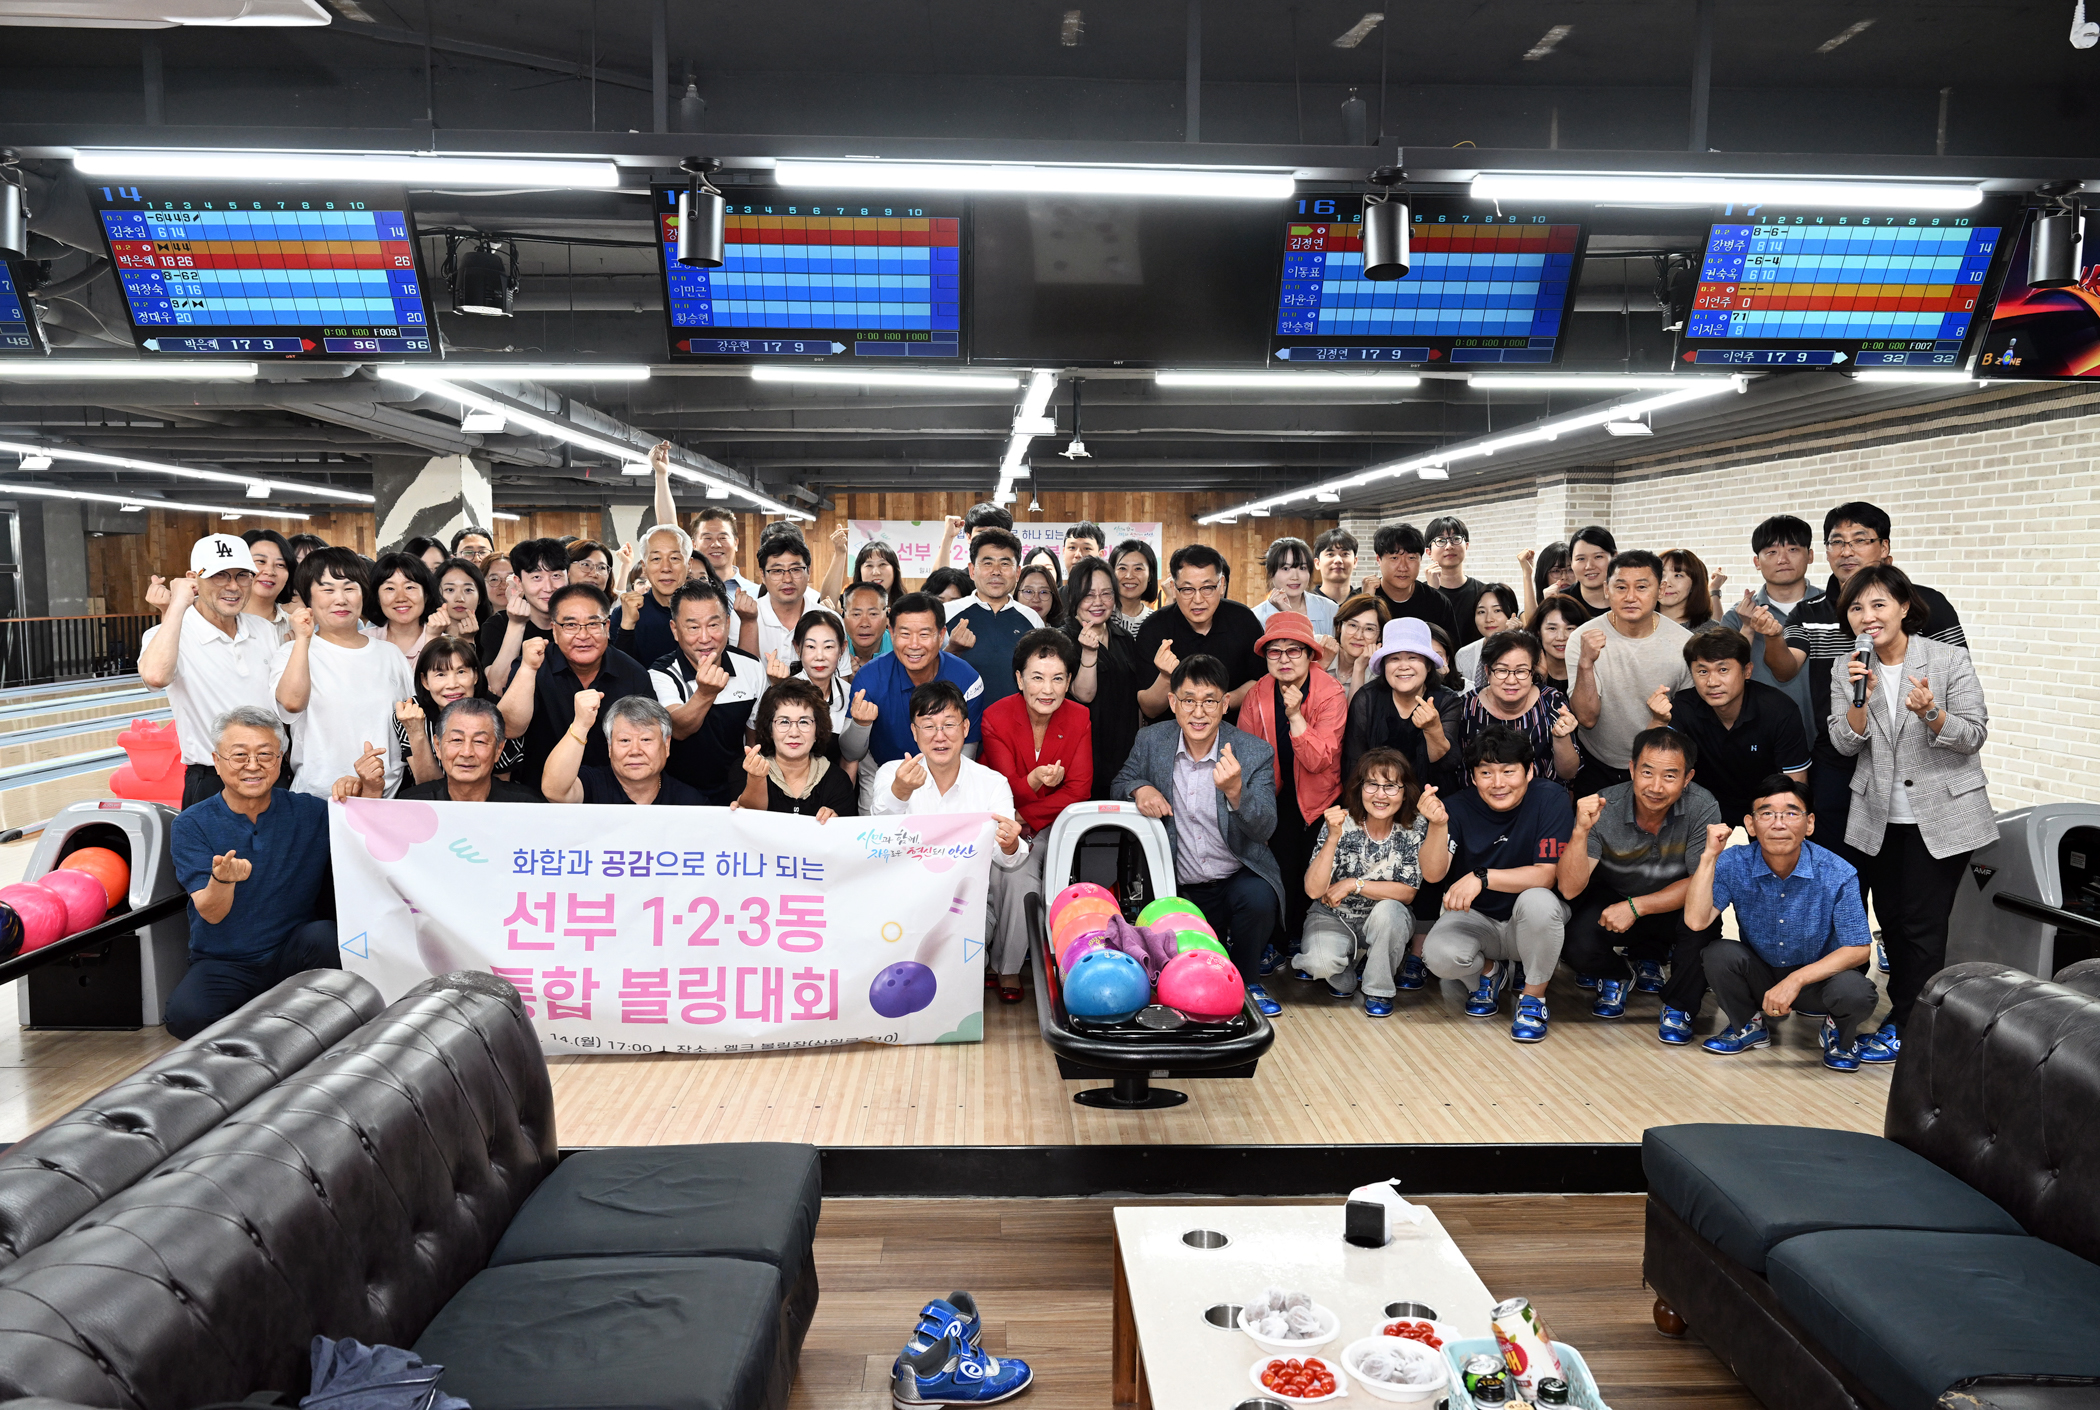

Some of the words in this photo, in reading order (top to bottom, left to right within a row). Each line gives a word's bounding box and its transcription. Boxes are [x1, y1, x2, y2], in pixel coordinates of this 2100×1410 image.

[98, 186, 143, 202] 14
[147, 201, 154, 210] 1
[165, 201, 174, 210] 2
[183, 201, 192, 210] 3
[204, 201, 213, 210] 4
[229, 201, 238, 210] 5
[252, 201, 262, 210] 6
[277, 201, 286, 210] 7
[301, 201, 310, 210] 8
[326, 201, 334, 210] 9
[349, 201, 365, 210] 10
[725, 206, 734, 214] 2
[744, 206, 752, 214] 3
[764, 206, 772, 214] 4
[789, 206, 797, 215] 5
[812, 207, 821, 215] 6
[837, 207, 844, 215] 7
[860, 208, 869, 216] 8
[884, 208, 892, 216] 9
[907, 208, 923, 216] 10
[1295, 199, 1336, 215] 16
[1336, 214, 1341, 222] 1
[1352, 214, 1361, 222] 2
[1414, 214, 1423, 222] 5
[1437, 215, 1446, 223] 6
[1462, 215, 1470, 223] 7
[1484, 215, 1493, 223] 8
[1508, 215, 1517, 224] 9
[1531, 215, 1546, 224] 10
[1761, 216, 1767, 224] 1
[1777, 216, 1786, 224] 2
[1795, 216, 1804, 224] 3
[1816, 216, 1824, 225] 4
[1839, 216, 1847, 225] 5
[1862, 217, 1870, 225] 6
[1886, 217, 1894, 225] 7
[1908, 217, 1917, 226] 8
[1931, 217, 1940, 226] 9
[1954, 218, 1969, 226] 10
[157, 227, 167, 238] 6
[169, 227, 186, 238] 14
[389, 226, 405, 238] 14
[1290, 237, 1324, 250] 김정연
[1712, 239, 1746, 252] 강병주
[1757, 241, 1766, 252] 8
[1769, 241, 1783, 252] 14
[1978, 242, 1993, 254] 14
[160, 256, 176, 267] 18
[176, 256, 194, 267] 26
[394, 256, 411, 267] 26
[1749, 269, 1758, 280] 6
[1762, 270, 1775, 280] 10
[1969, 270, 1983, 283] 10
[128, 283, 164, 296] 박창숙
[174, 284, 184, 295] 8
[186, 284, 202, 295] 16
[401, 284, 417, 295] 16
[674, 285, 707, 297] 이민근
[1699, 296, 1732, 308] 이언주
[1742, 298, 1751, 308] 0
[1964, 299, 1974, 310] 0
[12, 308, 20, 318] 9
[137, 311, 172, 324] 정대우
[175, 312, 192, 323] 20
[406, 312, 423, 323] 20
[324, 328, 347, 336] 0:00
[373, 328, 397, 336] F009
[1692, 323, 1724, 336] 이지은
[1735, 325, 1743, 335] 8
[1955, 326, 1964, 337] 8
[6, 337, 29, 346] 48
[856, 332, 879, 340] 0:00
[230, 339, 251, 350] 17
[263, 339, 274, 350] 9
[353, 340, 376, 349] 96
[406, 340, 429, 349] 96
[717, 341, 750, 353] 강우현
[762, 342, 782, 352] 17
[794, 342, 805, 352] 9
[1455, 339, 1478, 347] 0:00
[1862, 342, 1885, 350] 0:00
[1316, 348, 1348, 360] 김정연
[1361, 349, 1380, 359] 17
[1391, 349, 1402, 359] 9
[1723, 351, 1755, 363] 이언주
[1767, 352, 1787, 362] 17
[1796, 352, 1808, 363] 9
[1882, 354, 1904, 363] 32
[1933, 354, 1955, 363] 32
[1981, 352, 1993, 365] B
[1022, 529, 1042, 540] 하나
[214, 540, 233, 557] LA
[896, 543, 931, 561] 선부
[857, 828, 894, 850] 시민과
[947, 844, 979, 859] 안산
[512, 848, 593, 878] 화합과
[601, 849, 705, 878] 공감으로
[715, 853, 768, 879] 하나
[775, 853, 826, 882] 되는
[1974, 867, 1991, 875] AMF
[503, 889, 617, 952] 선부
[642, 894, 828, 954] 1·2·3동
[618, 966, 839, 1025] 볼링대회
[608, 1040, 652, 1053] 17:00
